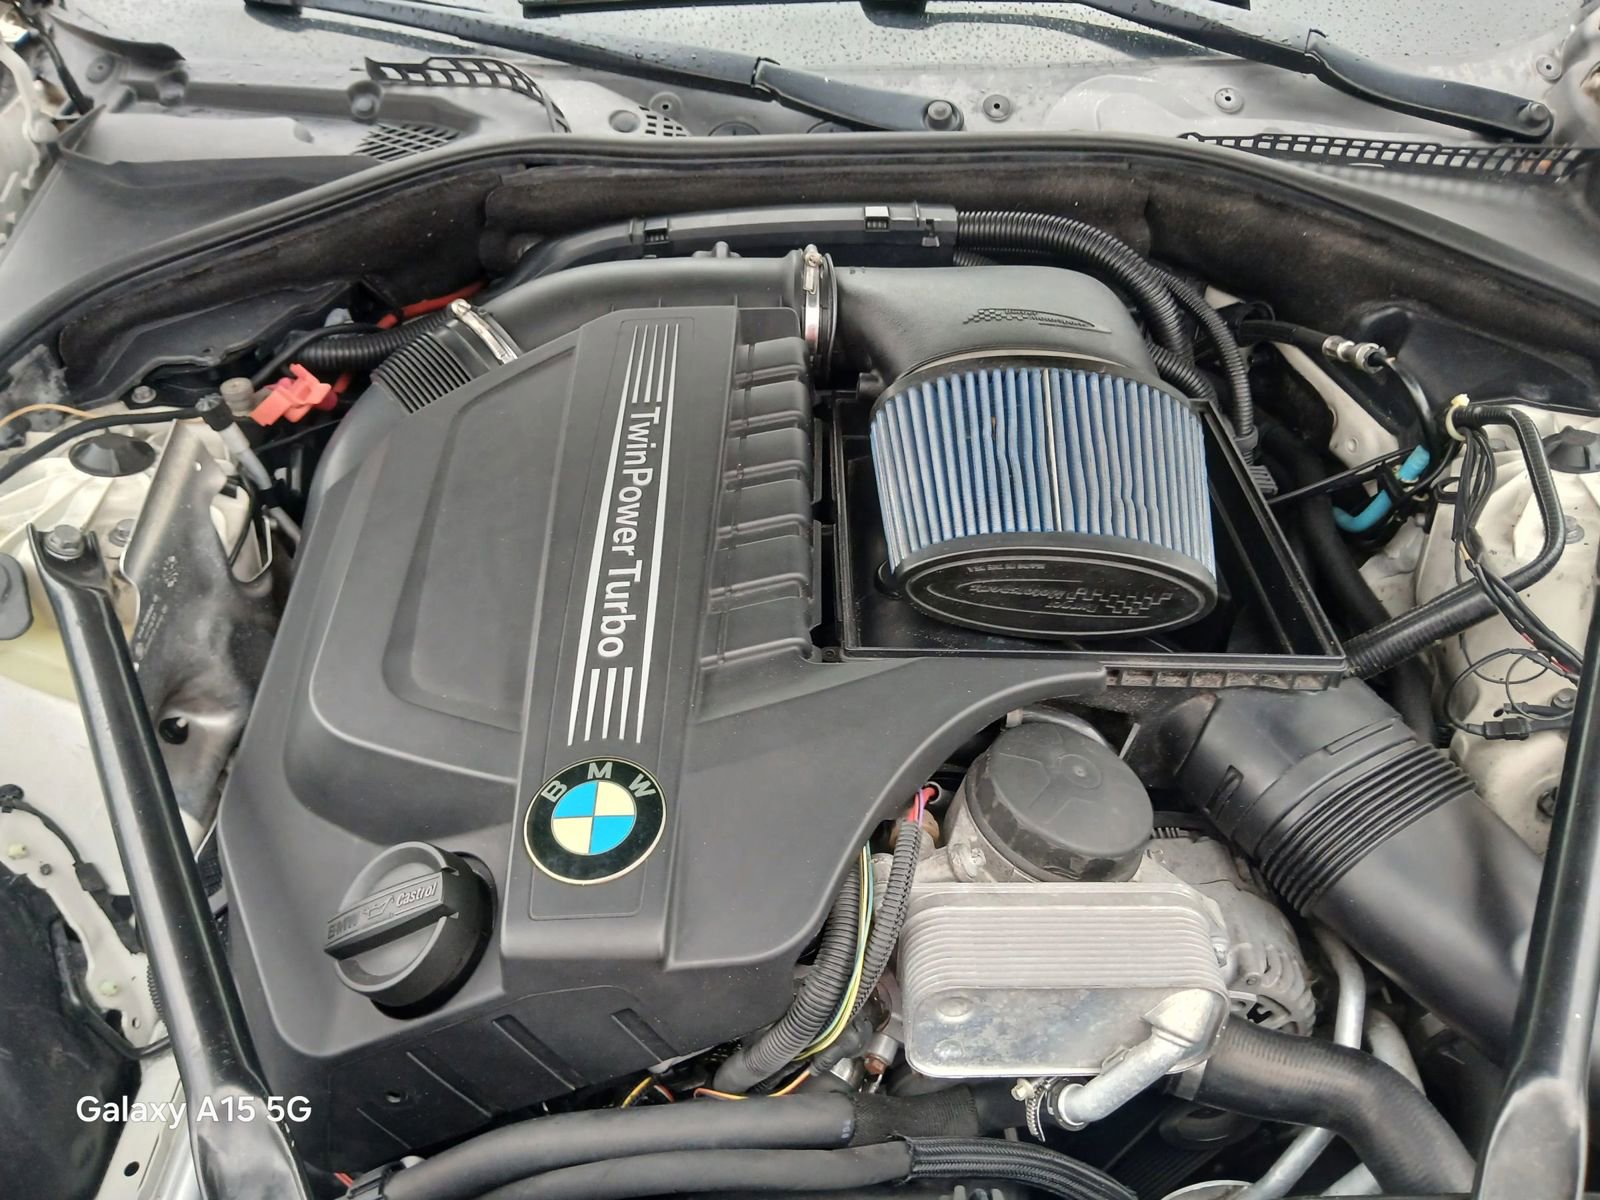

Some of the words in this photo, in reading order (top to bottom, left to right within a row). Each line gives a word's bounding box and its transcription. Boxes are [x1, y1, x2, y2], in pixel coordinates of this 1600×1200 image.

[612, 406, 660, 557] TwinPower
[597, 560, 643, 658] Turbo
[540, 761, 656, 803] BMW
[396, 882, 437, 907] Castrol
